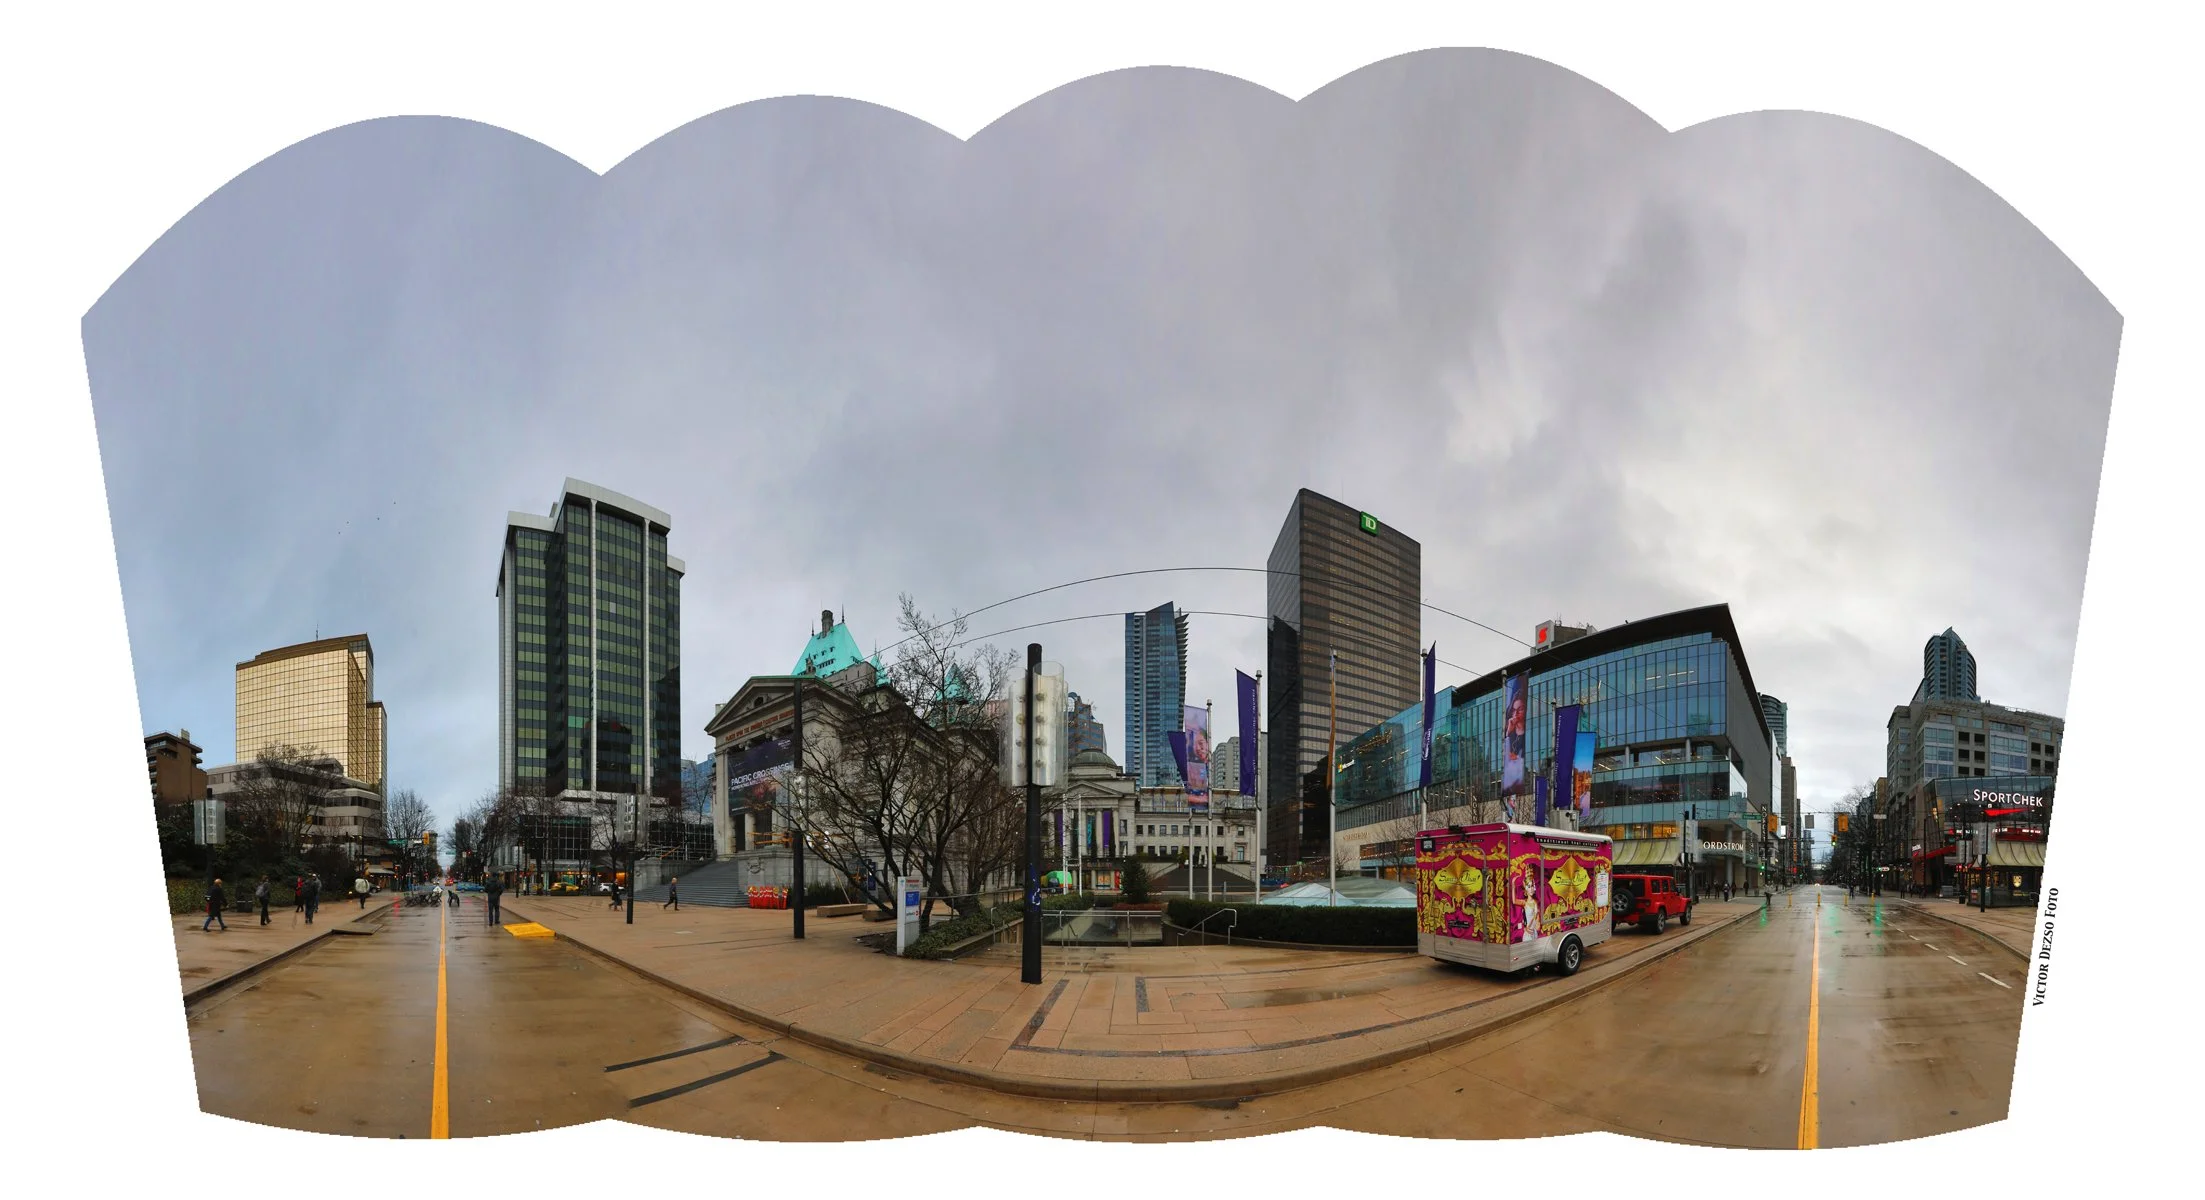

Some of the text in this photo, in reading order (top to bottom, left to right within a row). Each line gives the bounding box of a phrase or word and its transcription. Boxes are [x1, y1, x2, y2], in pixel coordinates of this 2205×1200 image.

[1362, 515, 1377, 530] TD
[731, 773, 752, 786] PACIFIC
[752, 763, 790, 781] CROSSINGS
[1703, 841, 1744, 851] ORDSTROM
